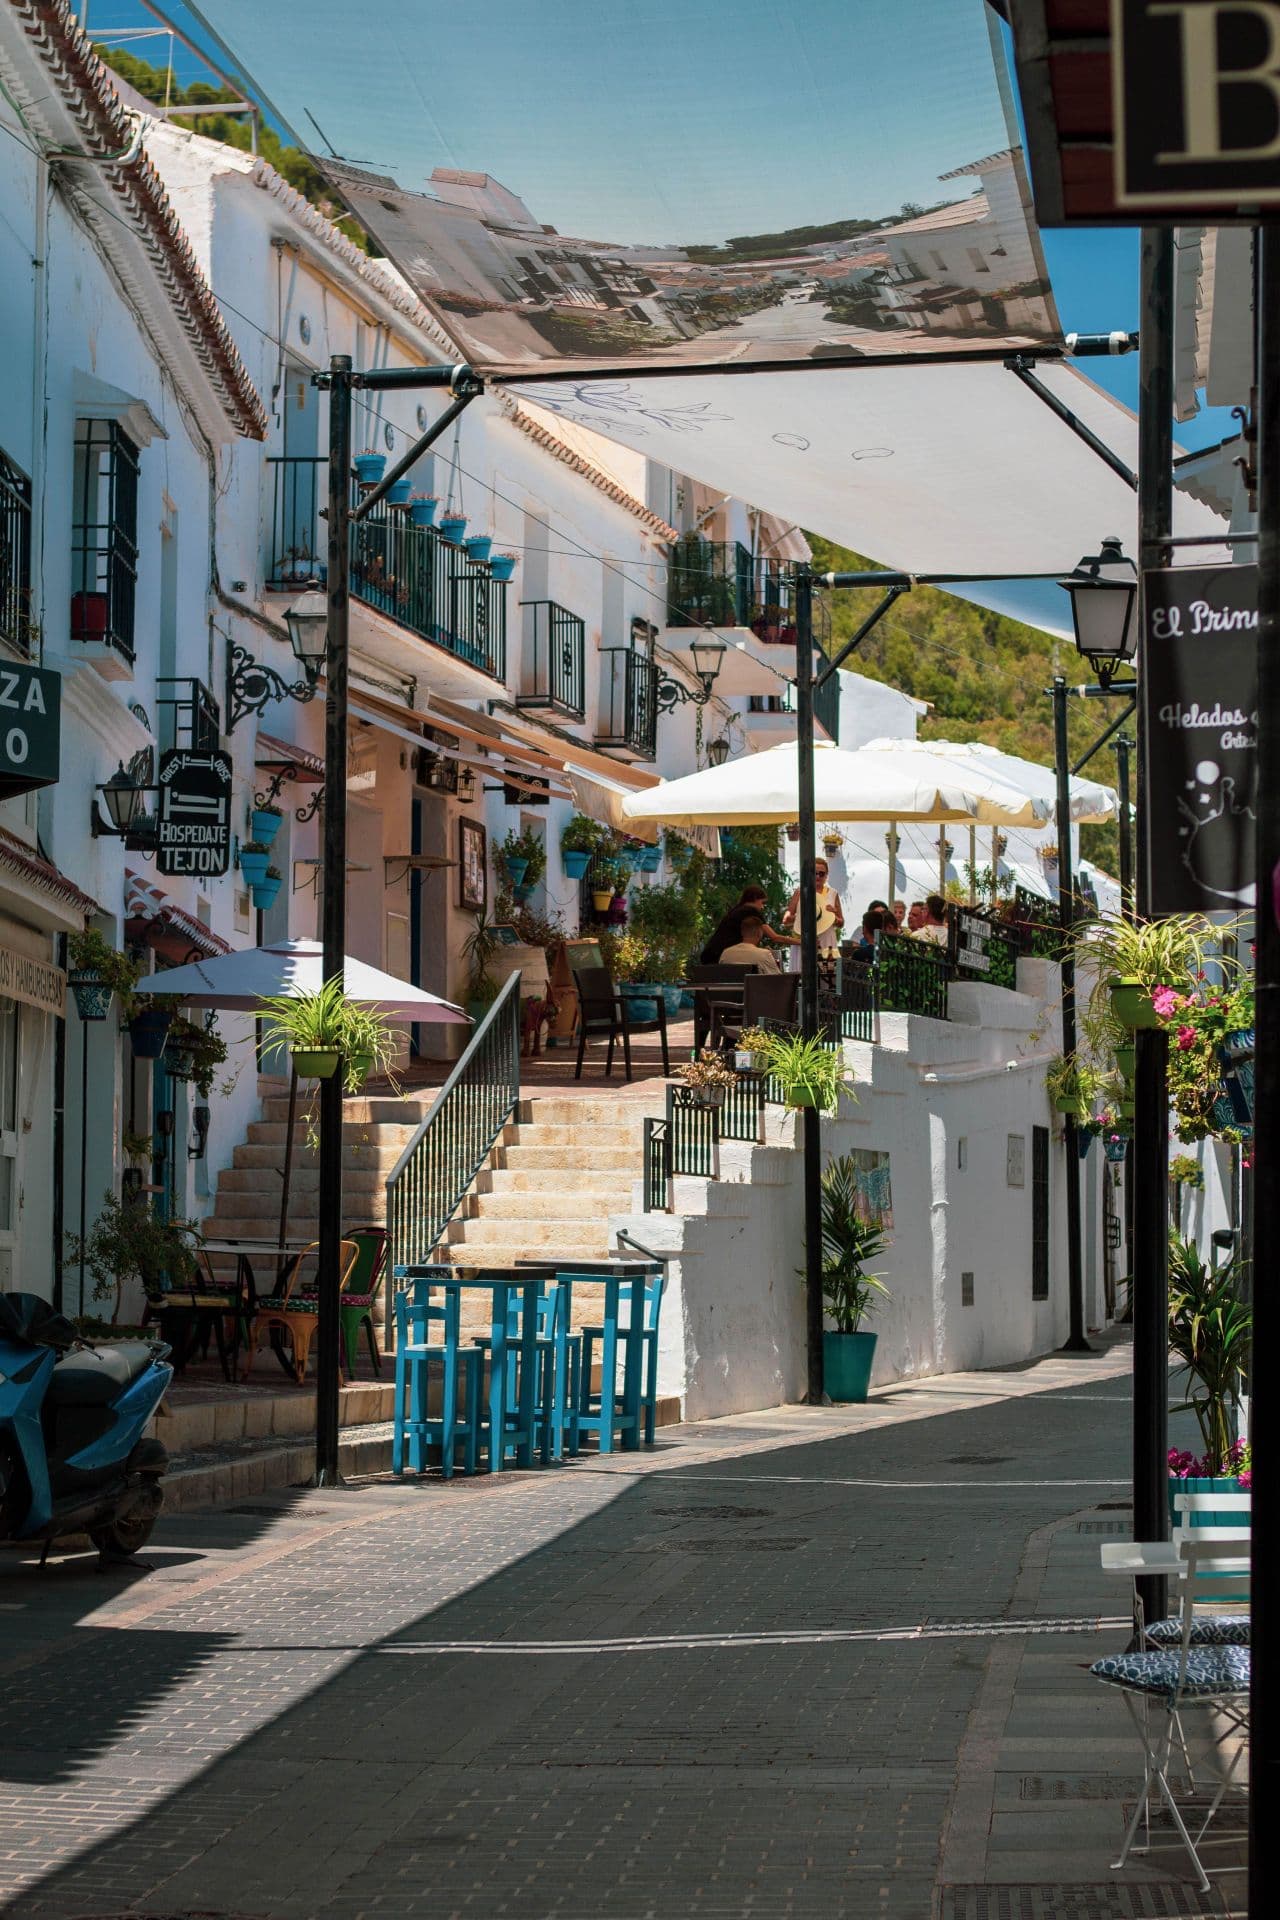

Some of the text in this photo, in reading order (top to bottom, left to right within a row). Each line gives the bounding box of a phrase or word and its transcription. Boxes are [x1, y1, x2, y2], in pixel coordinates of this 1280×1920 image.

[1145, 1, 1280, 165] B
[1152, 606, 1184, 639] El
[1159, 702, 1248, 728] Helados
[6, 727, 29, 764] O
[160, 756, 182, 783] GUEST
[160, 822, 228, 844] HOSPEDAJE
[161, 846, 225, 872] TEJON
[15, 955, 63, 1009] HAMBURGUESAS
